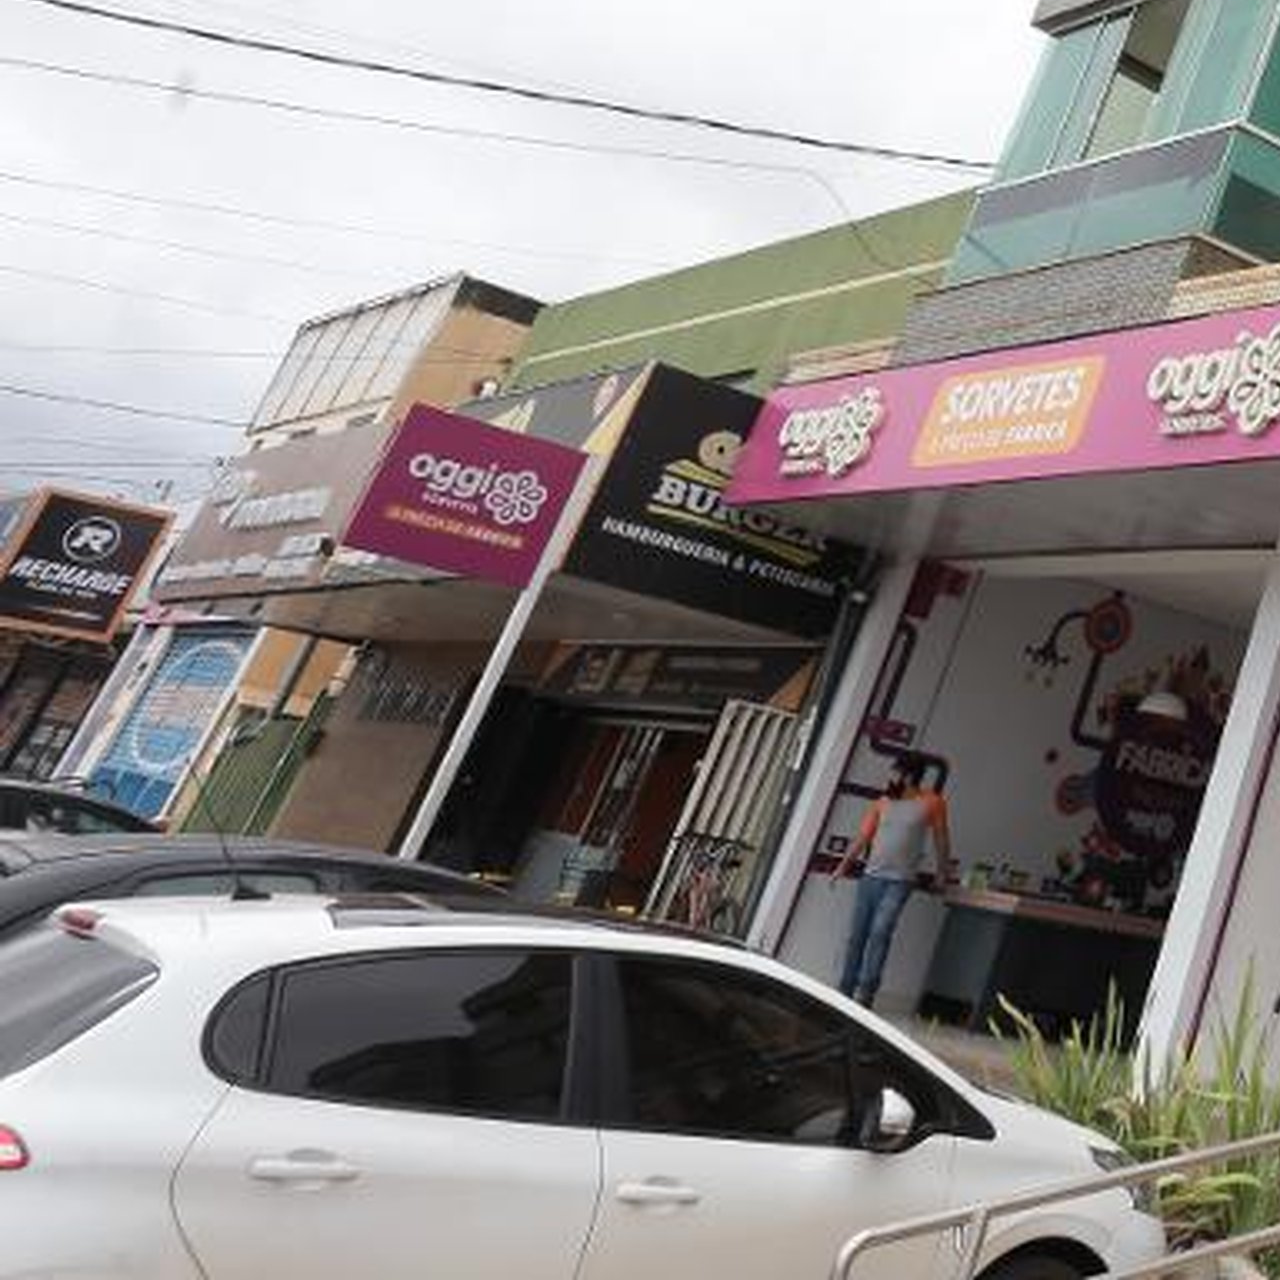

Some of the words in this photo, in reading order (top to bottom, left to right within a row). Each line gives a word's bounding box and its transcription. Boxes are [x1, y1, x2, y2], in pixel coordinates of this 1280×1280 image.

[943, 367, 1086, 423] SORVETES
[1147, 332, 1251, 412] oggi
[409, 454, 498, 498] oggi
[8, 554, 134, 597] RECHARGE
